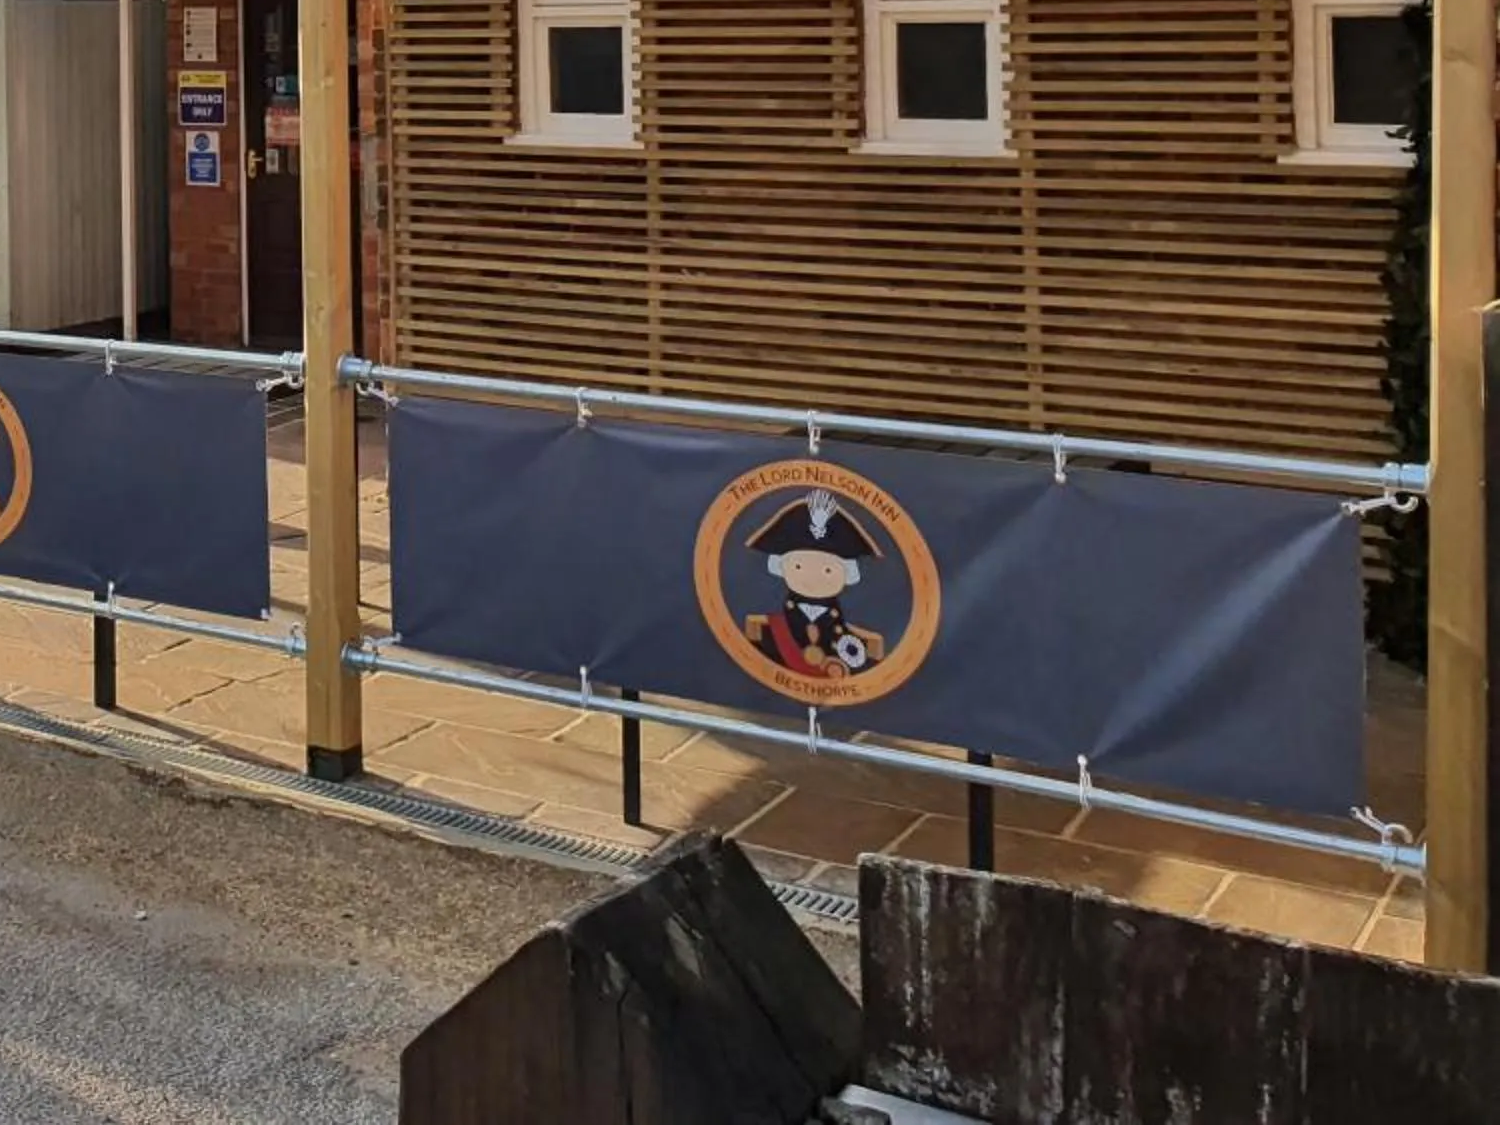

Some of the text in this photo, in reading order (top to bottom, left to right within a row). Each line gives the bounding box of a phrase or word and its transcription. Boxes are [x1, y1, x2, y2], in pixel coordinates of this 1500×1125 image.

[728, 466, 900, 523] THE LORD NELSON INN
